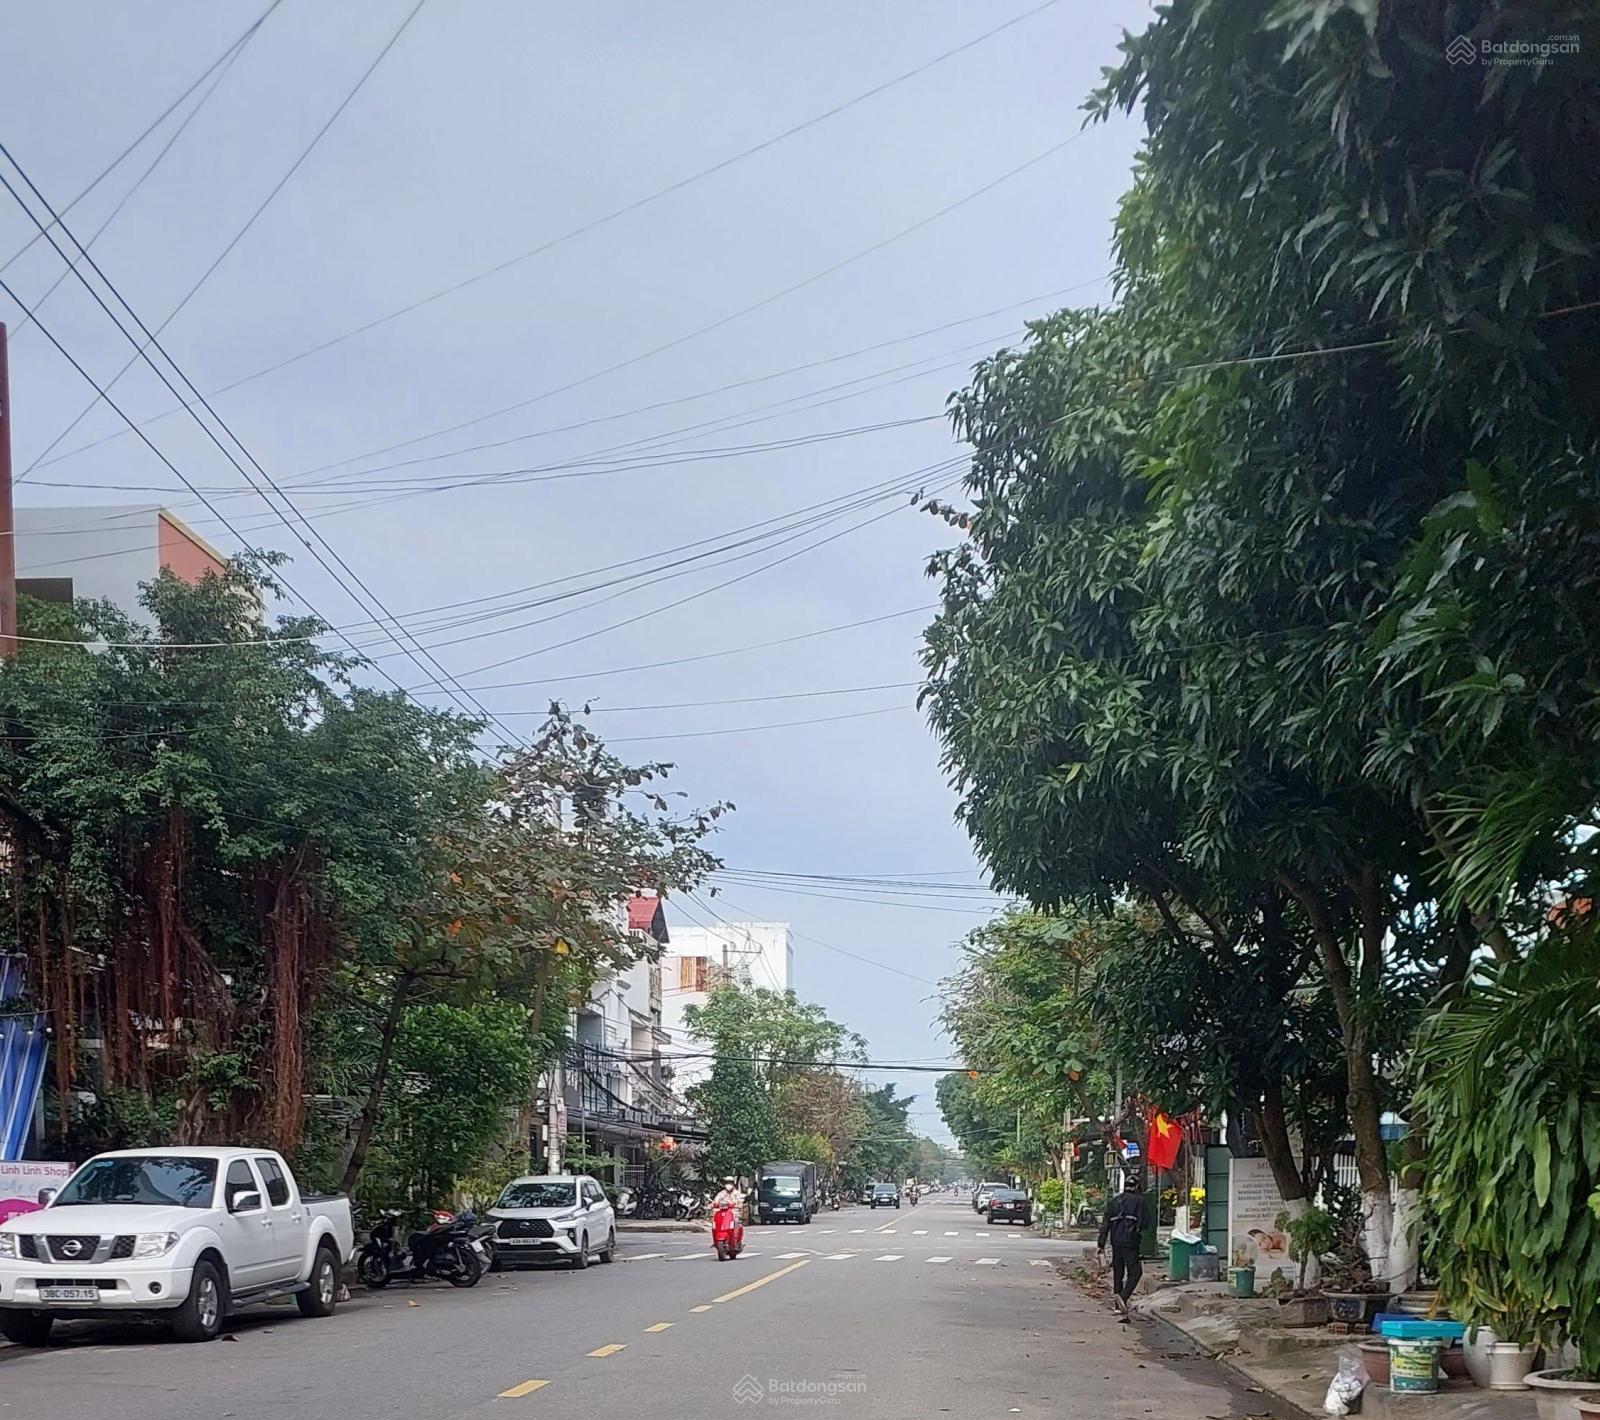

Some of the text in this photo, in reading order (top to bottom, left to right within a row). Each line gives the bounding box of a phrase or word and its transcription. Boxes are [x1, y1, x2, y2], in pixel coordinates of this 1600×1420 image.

[1, 1165, 68, 1177] Linh Linh Shop
[44, 1289, 94, 1298] 38C-057.15
